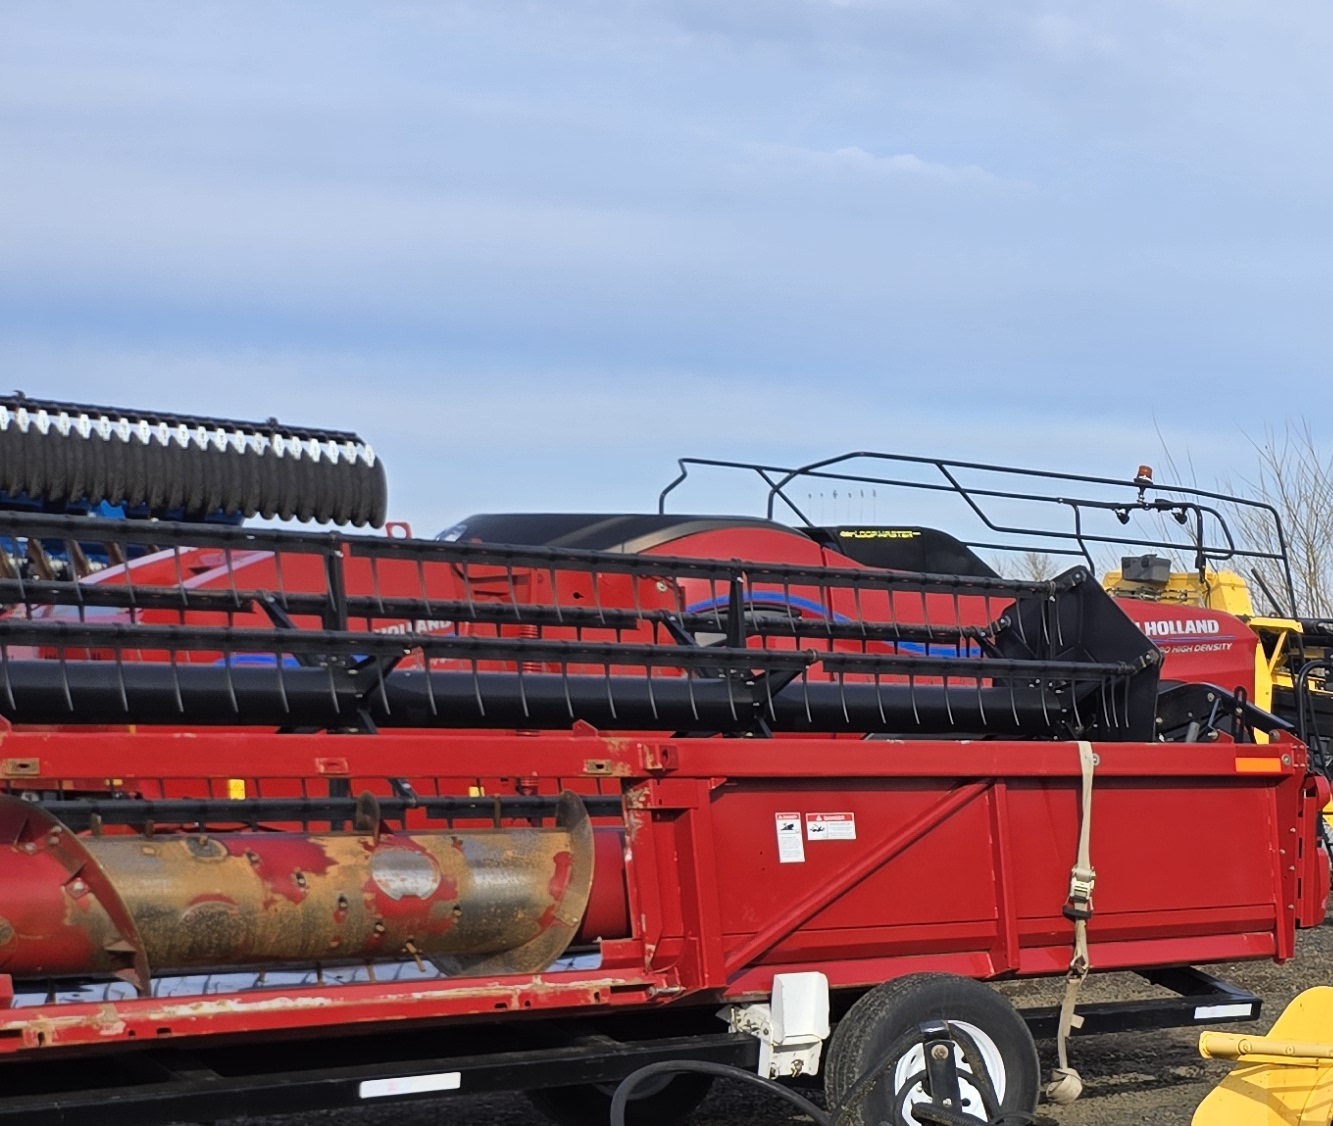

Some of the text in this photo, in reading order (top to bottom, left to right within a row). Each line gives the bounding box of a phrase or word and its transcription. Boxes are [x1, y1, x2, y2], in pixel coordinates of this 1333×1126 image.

[1144, 620, 1219, 635] HOLLAND
[1172, 644, 1193, 653] HIGH
[1194, 642, 1233, 652] DENSITY
